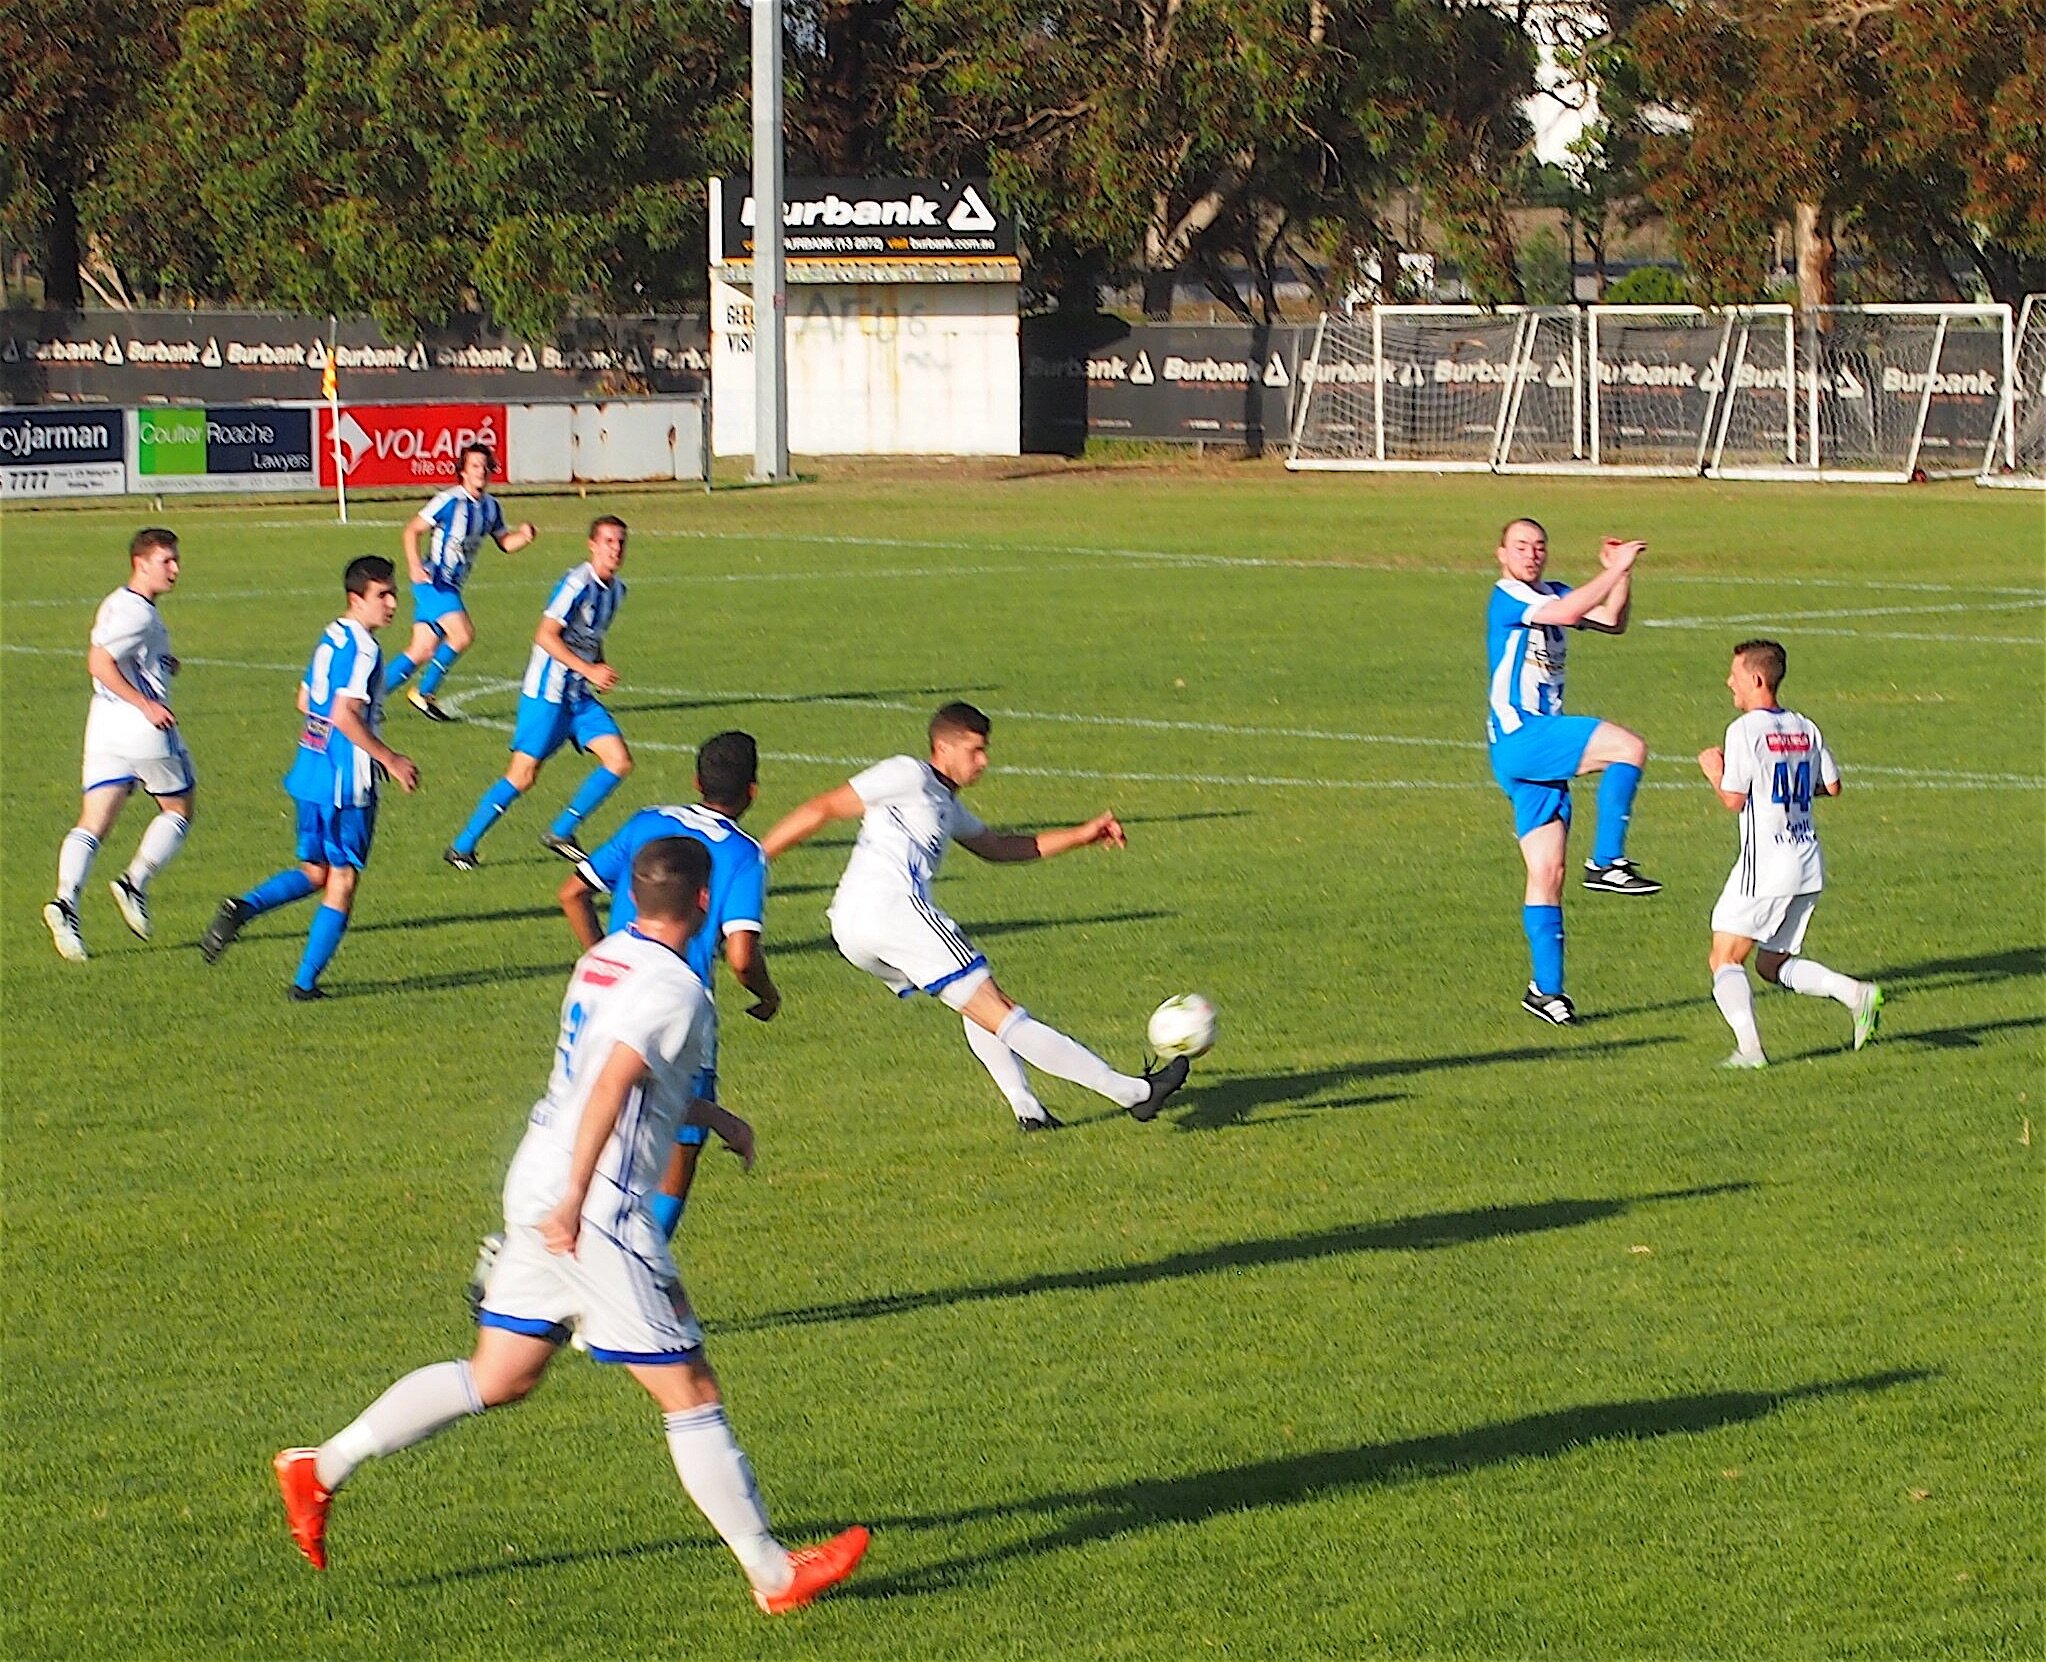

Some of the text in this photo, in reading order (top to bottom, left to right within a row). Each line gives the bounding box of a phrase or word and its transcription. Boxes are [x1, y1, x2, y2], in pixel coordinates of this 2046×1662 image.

[126, 339, 201, 363] Burbank
[226, 342, 306, 366] Burbank
[335, 345, 408, 368] Burbank
[1163, 357, 1262, 383] Burbank
[1597, 360, 1697, 387] urbank
[207, 421, 275, 445] Roache
[9, 471, 49, 491] 7777
[1771, 761, 1812, 813] 44
